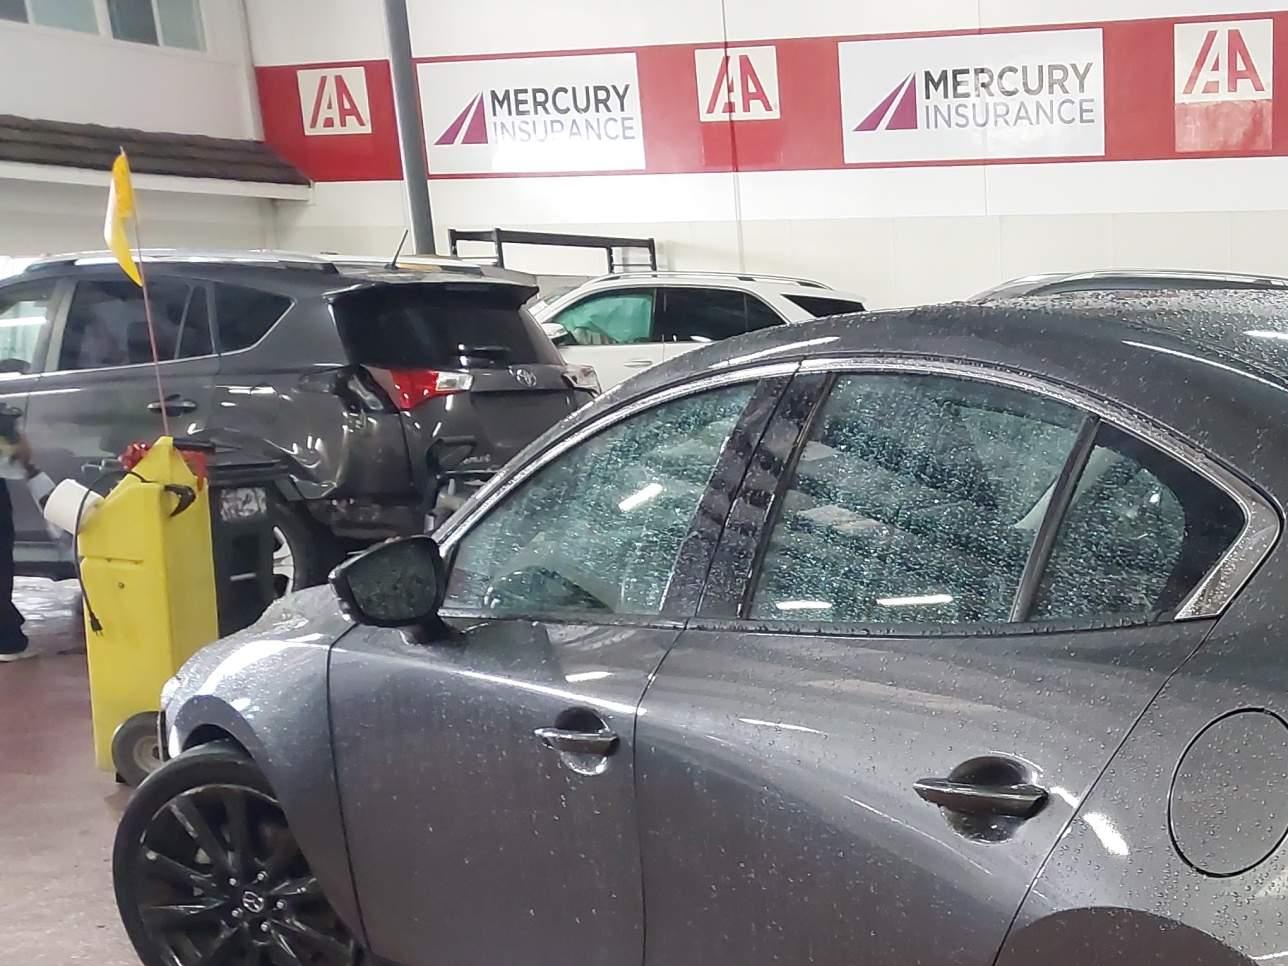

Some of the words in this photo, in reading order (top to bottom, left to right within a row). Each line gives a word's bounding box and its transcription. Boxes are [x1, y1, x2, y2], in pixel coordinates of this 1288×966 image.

[924, 62, 1093, 99] MERCURY
[490, 84, 630, 116] MERCURY
[925, 98, 1095, 129] INSURANCE
